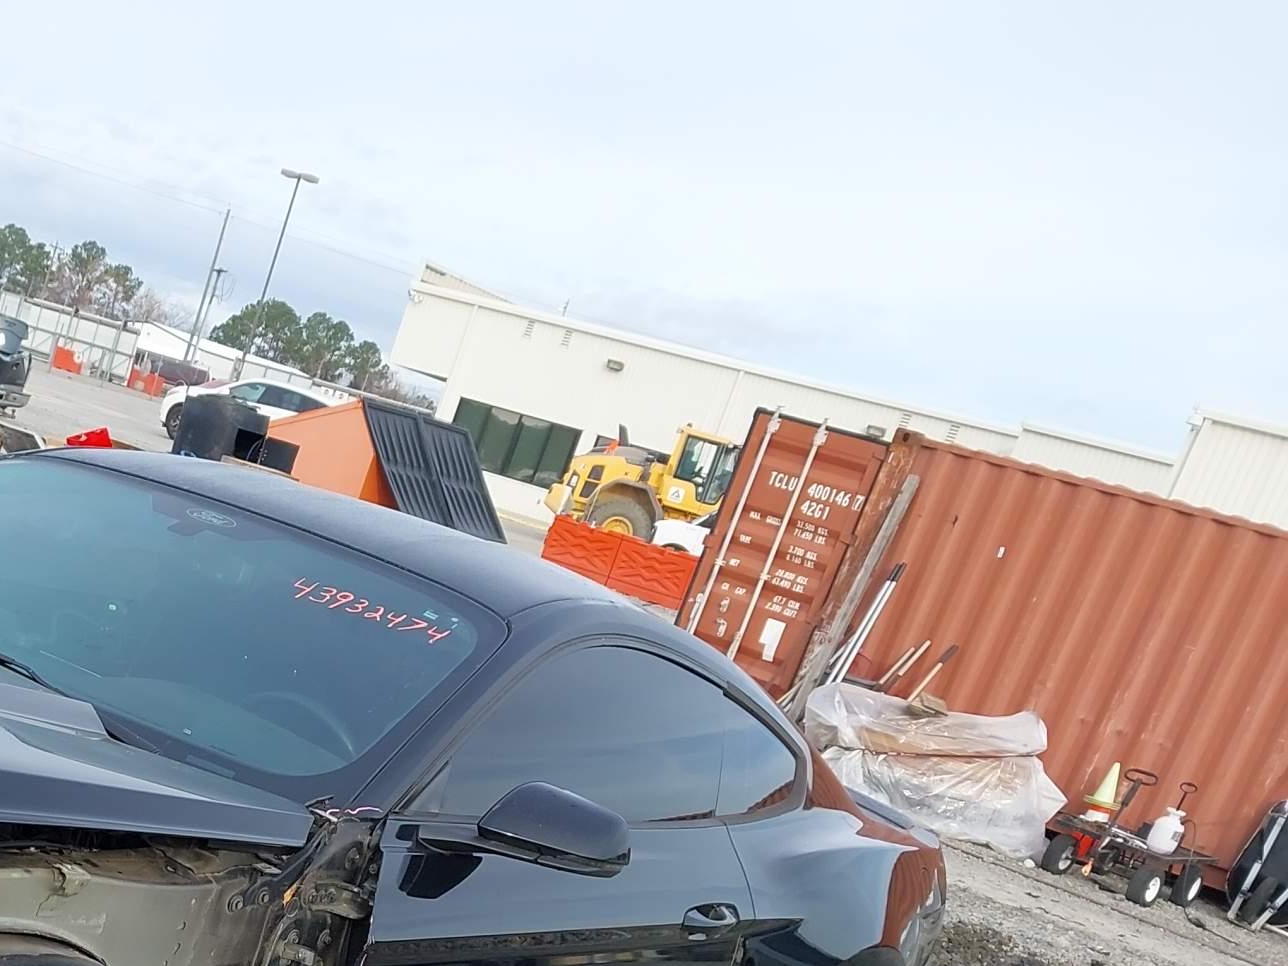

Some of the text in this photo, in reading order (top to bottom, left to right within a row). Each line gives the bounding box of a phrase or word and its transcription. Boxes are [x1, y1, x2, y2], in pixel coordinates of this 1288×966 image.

[769, 471, 866, 512] TCLU 400146 7
[800, 500, 831, 520] 42G1
[293, 576, 452, 644] 43932474
